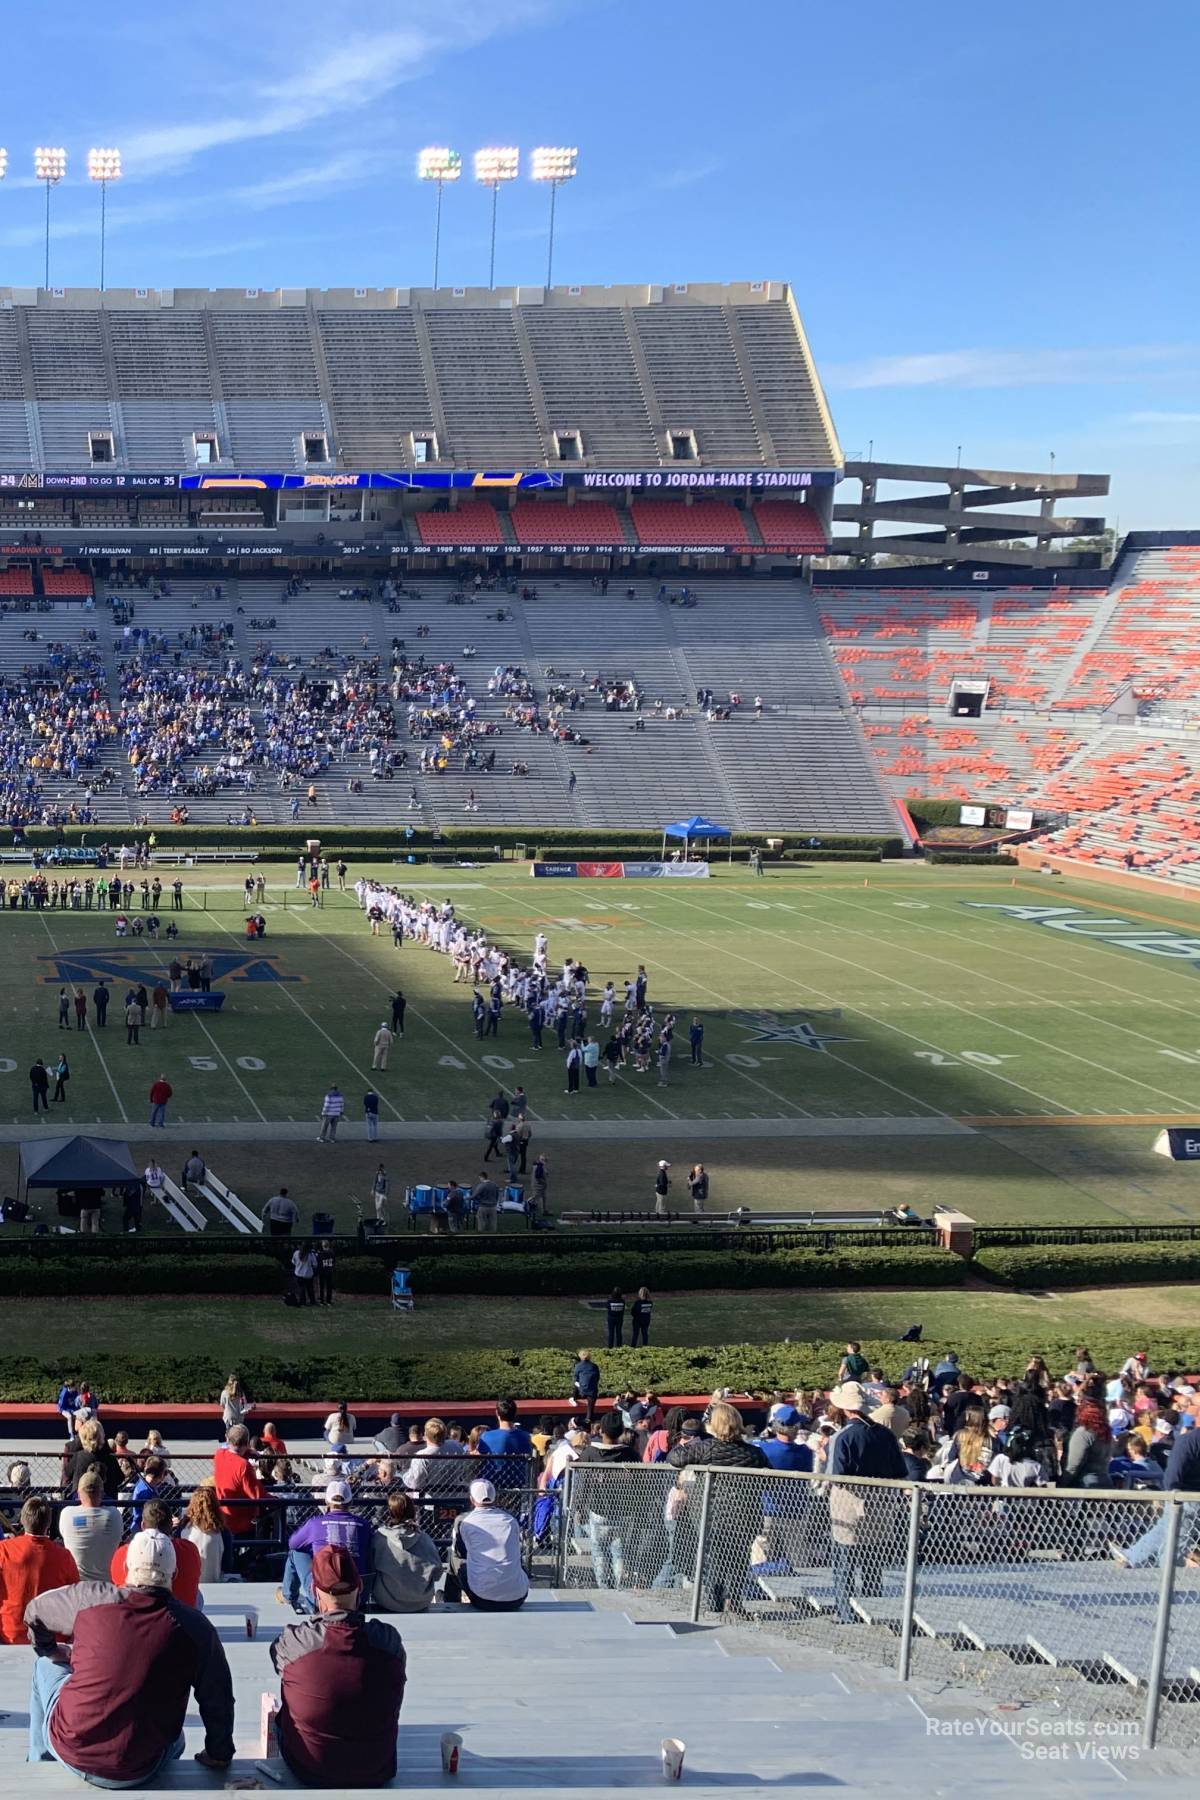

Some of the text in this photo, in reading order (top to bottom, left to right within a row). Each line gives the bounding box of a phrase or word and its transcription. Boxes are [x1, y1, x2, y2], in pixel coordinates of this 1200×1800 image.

[0, 475, 15, 485] 24
[70, 477, 87, 485] 2ND
[116, 476, 125, 485] 12
[163, 476, 175, 485] 35
[303, 475, 360, 487] PIEDMONT
[584, 473, 812, 486] WELCOME TO JORDAN-HARE STADIUM
[187, 1056, 267, 1071] 50
[437, 1055, 515, 1070] 40
[439, 1509, 457, 1520] 28
